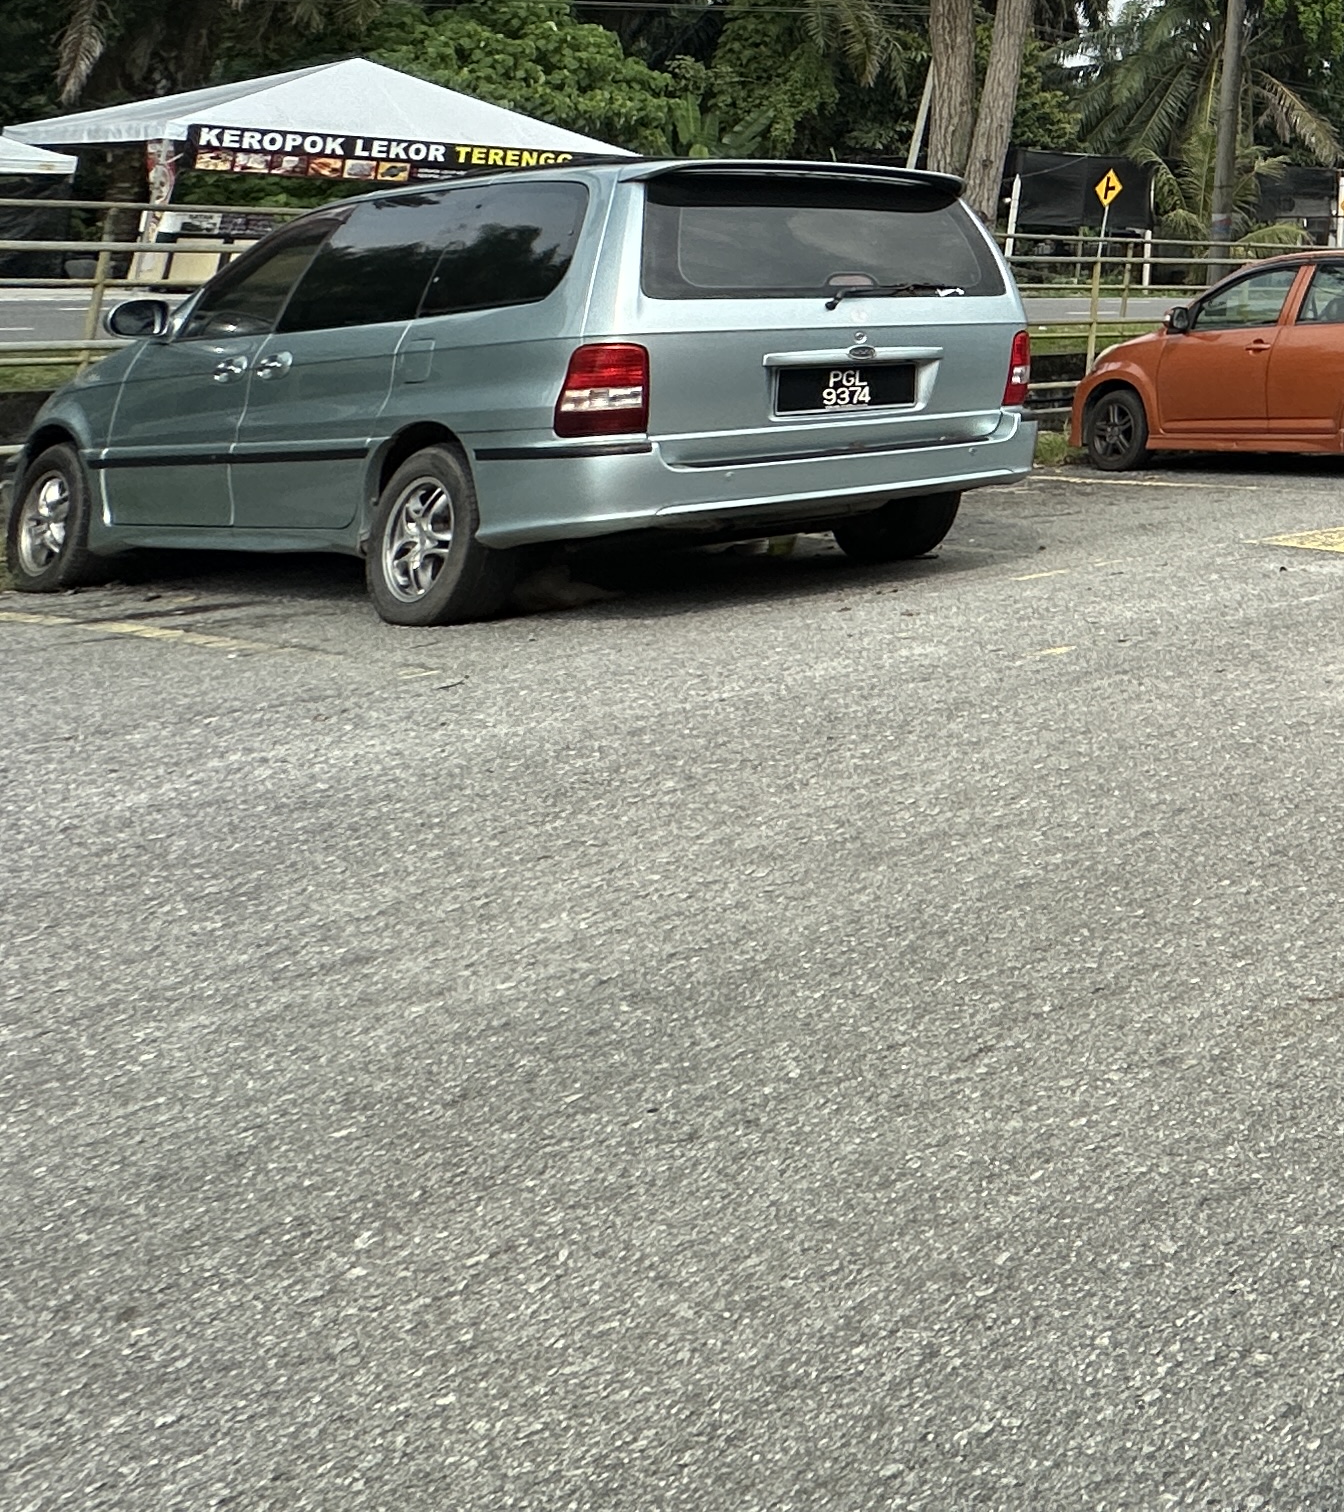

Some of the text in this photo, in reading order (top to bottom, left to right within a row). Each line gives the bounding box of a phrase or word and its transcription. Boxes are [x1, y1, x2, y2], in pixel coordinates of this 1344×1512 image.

[199, 126, 346, 156] KEROPOK
[353, 136, 446, 163] LEKOR
[828, 370, 868, 388] PGL
[822, 385, 872, 406] 9374
